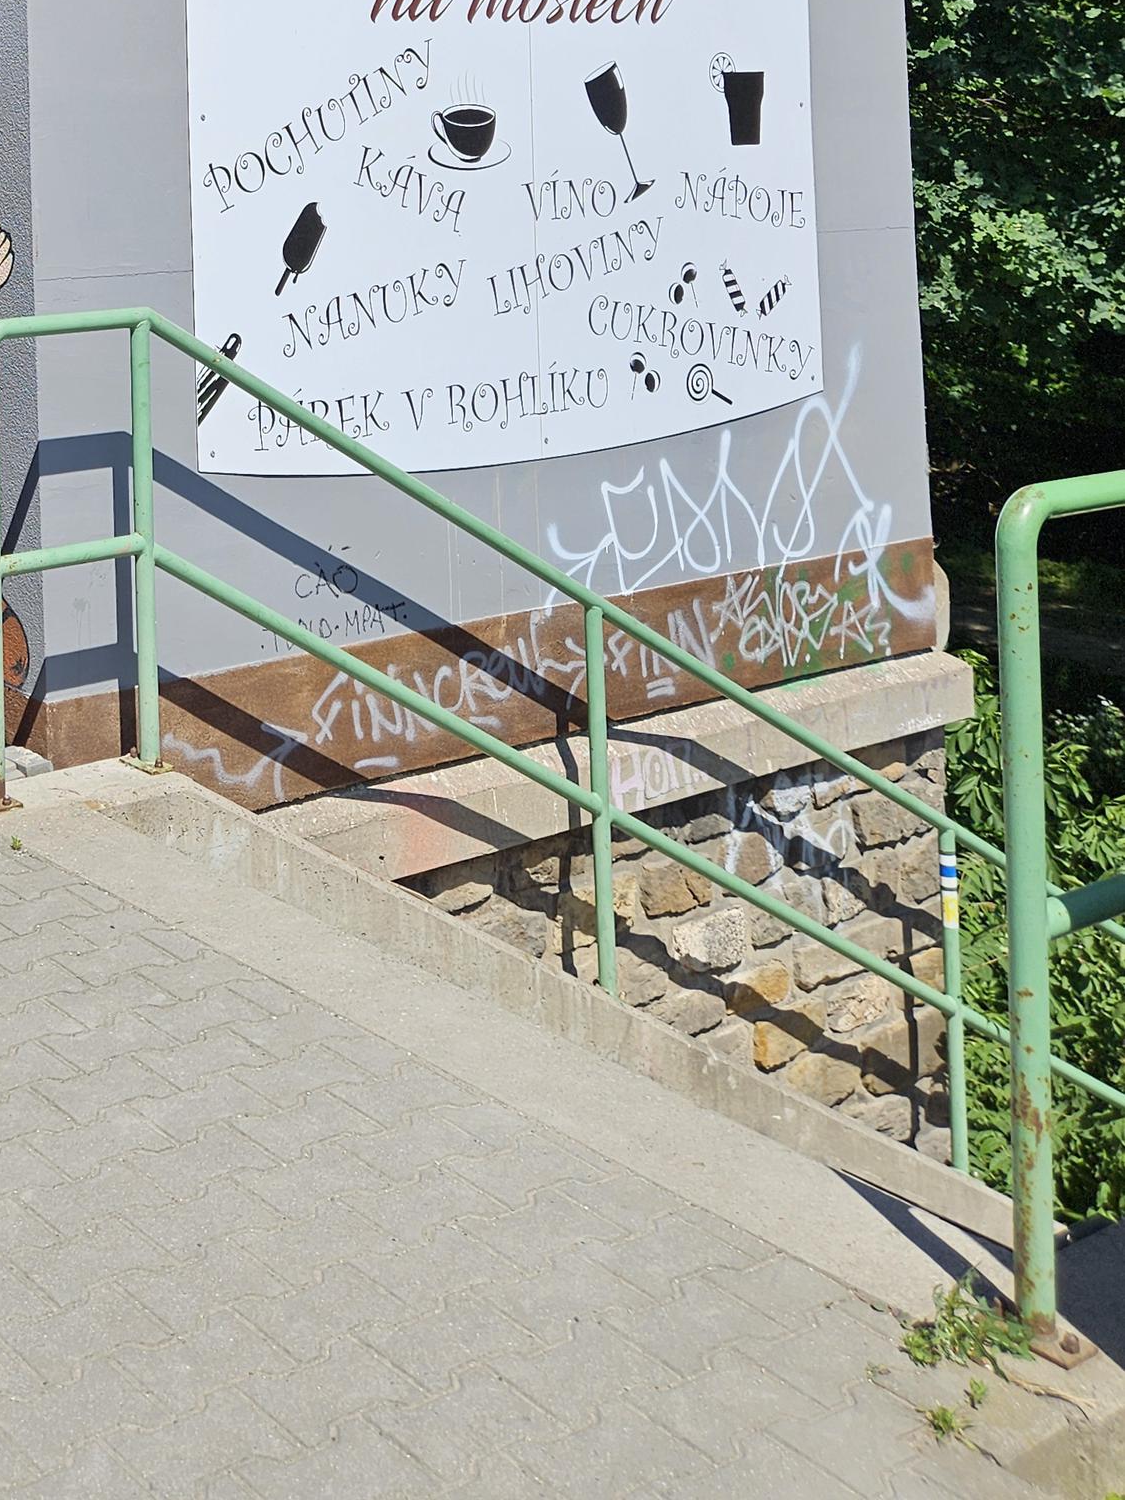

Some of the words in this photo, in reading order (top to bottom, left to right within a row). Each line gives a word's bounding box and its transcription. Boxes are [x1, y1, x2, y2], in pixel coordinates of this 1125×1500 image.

[202, 38, 434, 214] POCHUTINY
[353, 144, 466, 233] KÁVA
[521, 169, 617, 222] VÍNO
[674, 166, 806, 229] NÁPOJE
[282, 259, 467, 359] NANUKY
[486, 216, 664, 317] LIHOVINY
[588, 294, 815, 381] CUKROVINKY
[401, 387, 434, 432] V
[445, 360, 610, 434] ROHLÍKU
